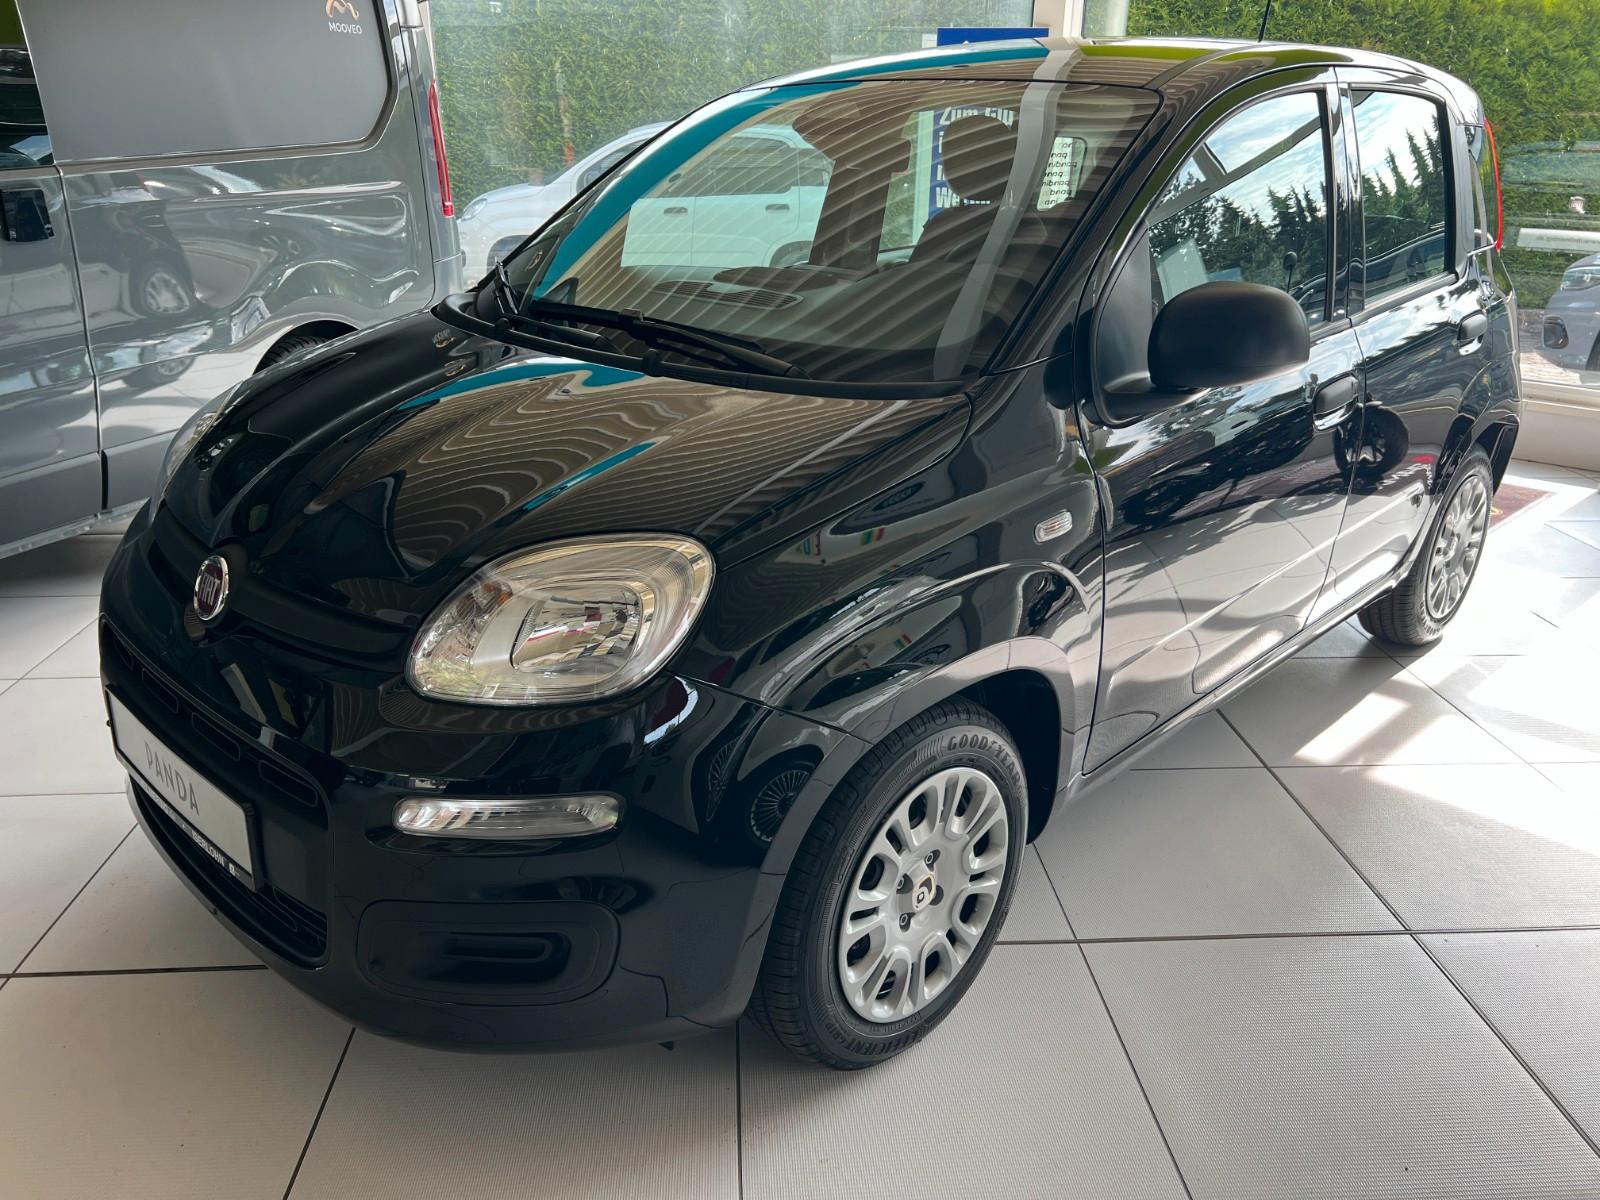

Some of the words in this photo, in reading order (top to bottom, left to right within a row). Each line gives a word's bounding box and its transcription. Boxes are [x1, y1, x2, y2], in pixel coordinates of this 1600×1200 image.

[328, 21, 362, 35] MOOVEO
[199, 572, 221, 606] FIAT
[144, 740, 200, 816] PANDA
[947, 733, 1021, 786] GOODYEAR
